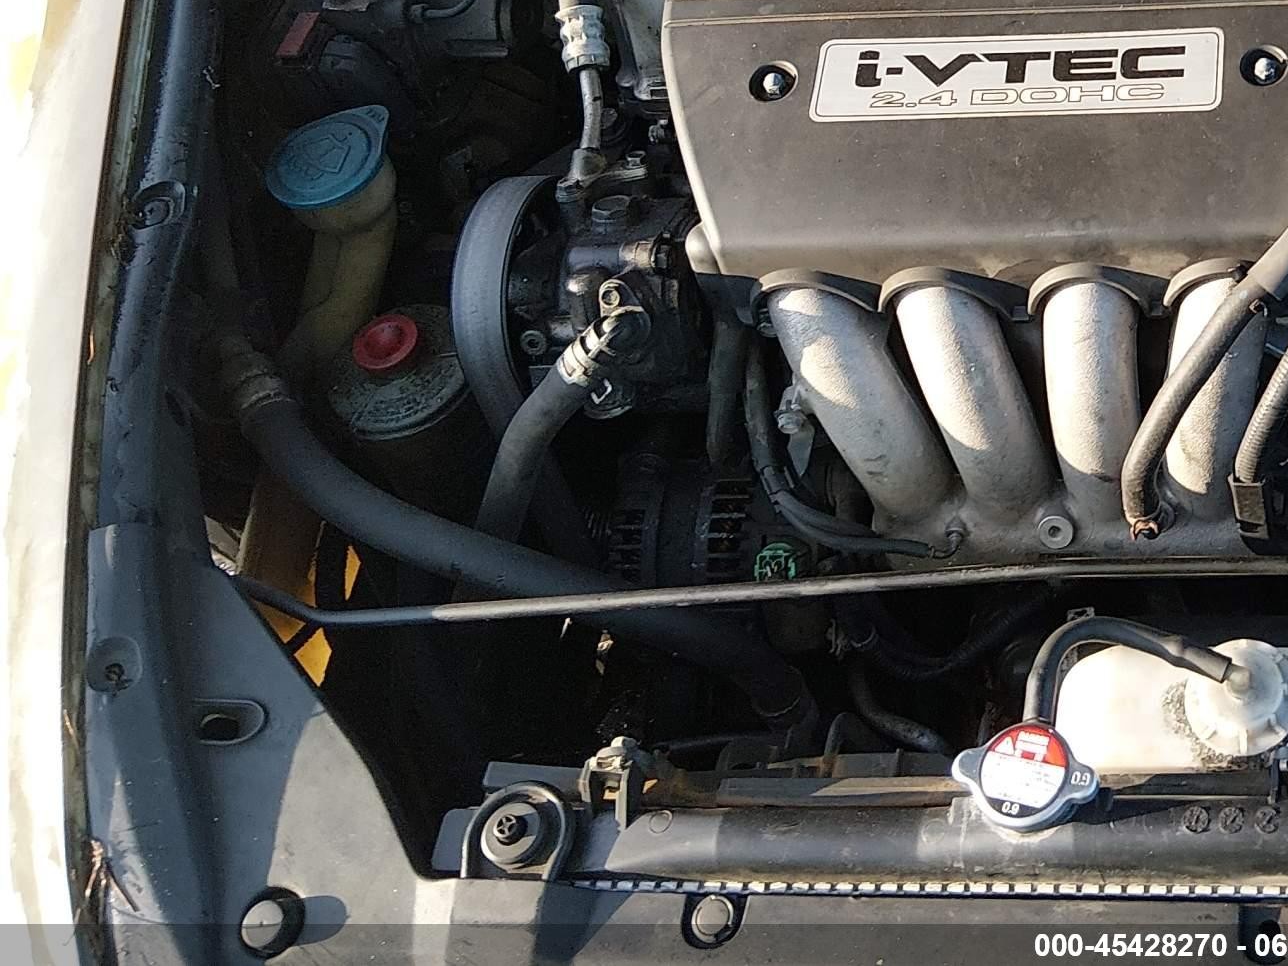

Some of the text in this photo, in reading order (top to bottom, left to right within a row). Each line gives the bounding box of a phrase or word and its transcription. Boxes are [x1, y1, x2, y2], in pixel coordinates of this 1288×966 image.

[854, 45, 1186, 88] i-VTEC
[869, 83, 1165, 109] 2.4 DOHC
[1071, 771, 1091, 786] 0.9
[1001, 801, 1020, 815] 0.9
